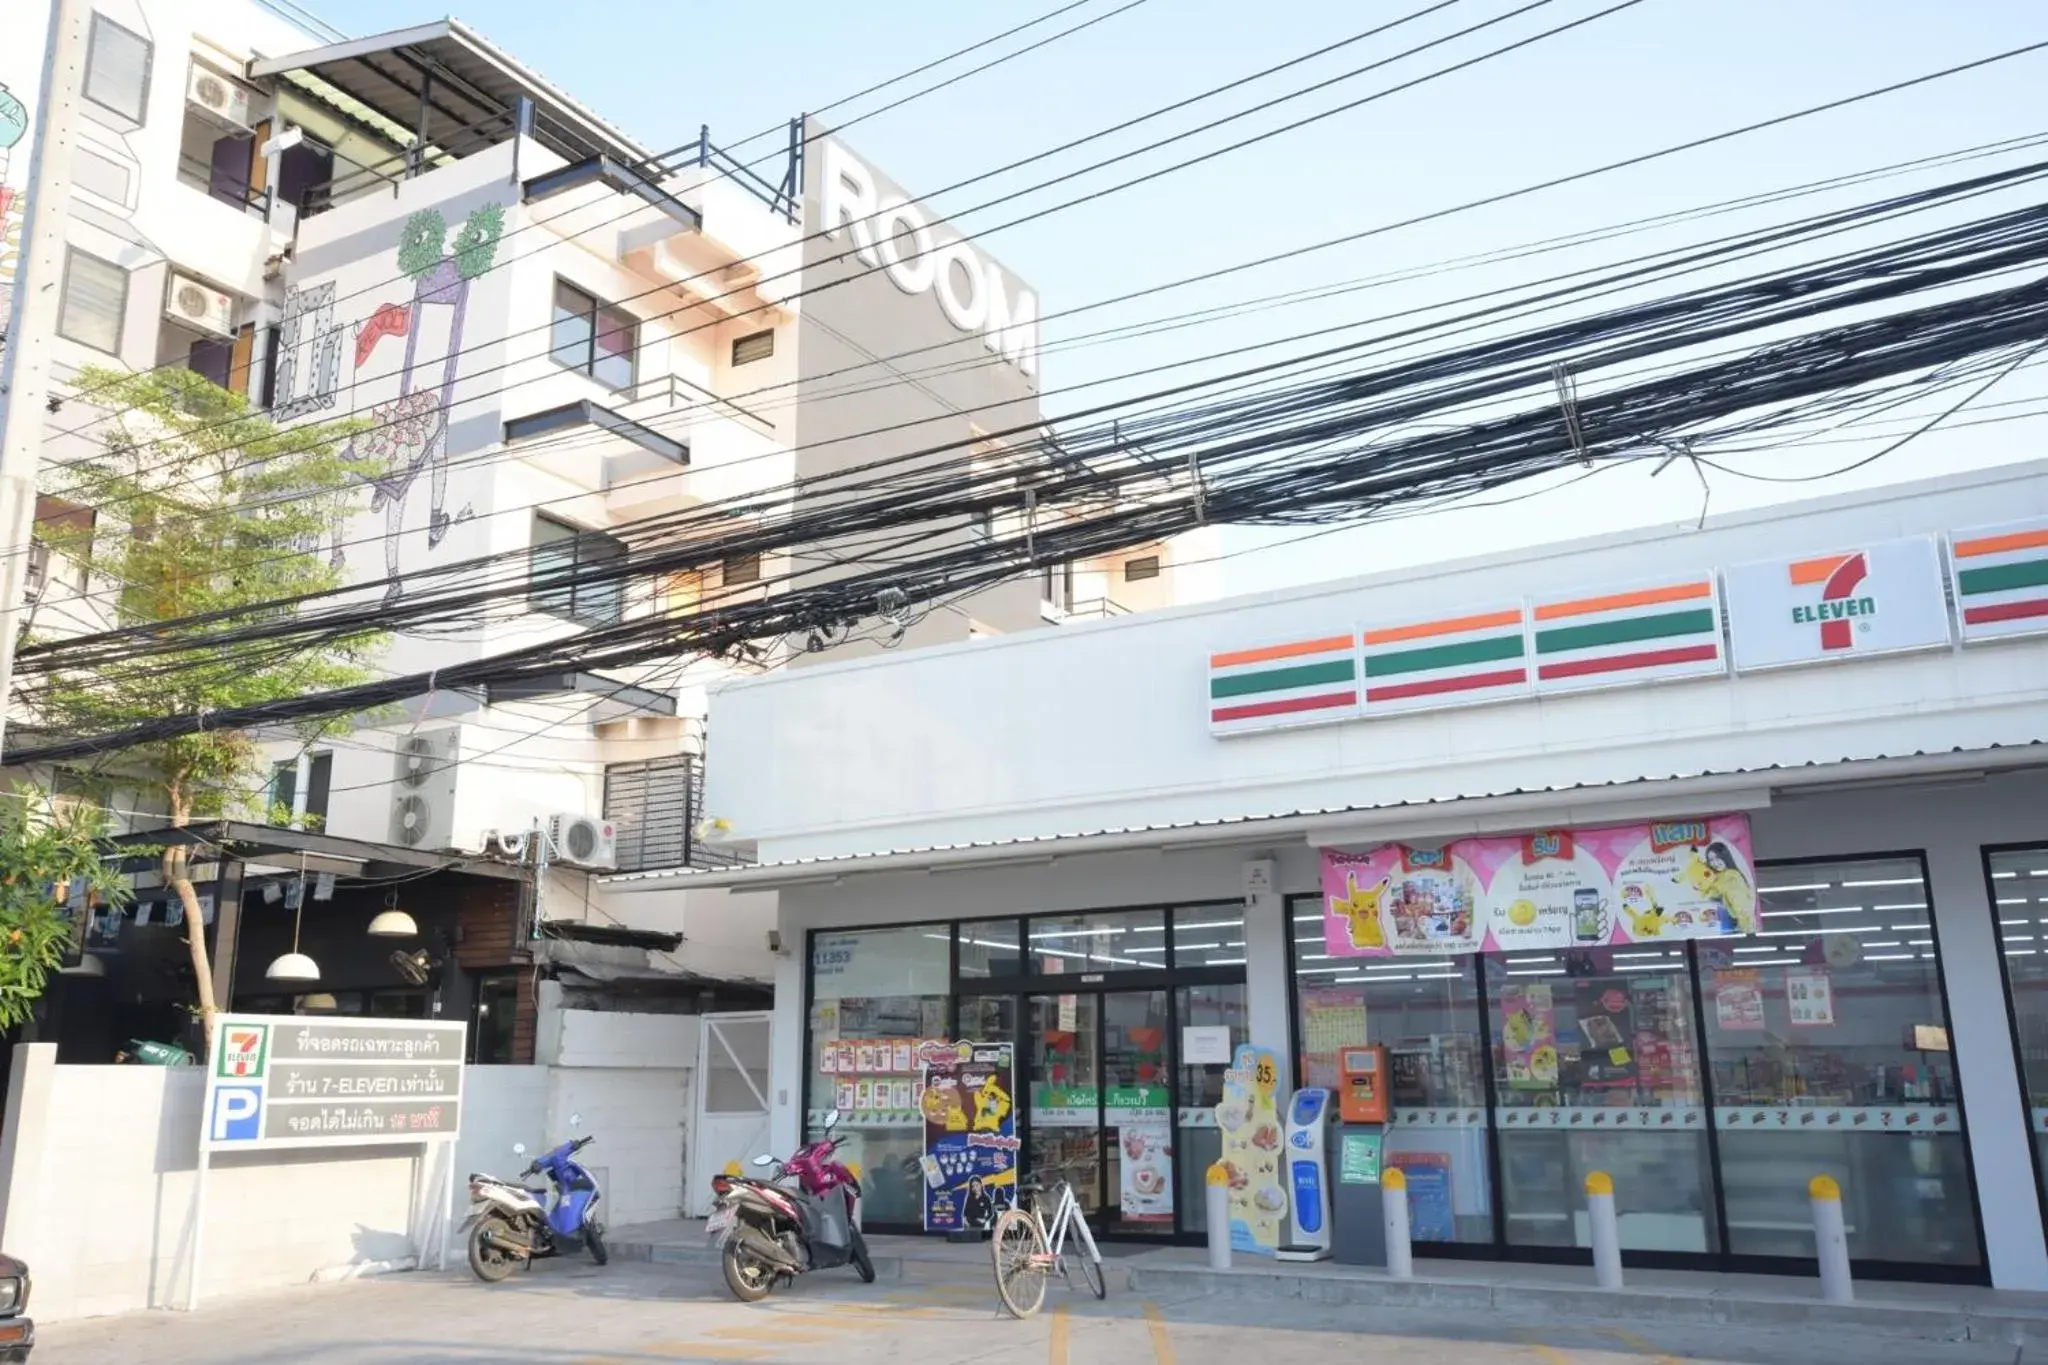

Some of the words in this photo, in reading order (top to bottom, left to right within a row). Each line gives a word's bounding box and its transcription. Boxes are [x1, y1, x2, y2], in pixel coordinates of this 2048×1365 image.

[821, 138, 1038, 377] ROOM
[1789, 552, 1867, 650] 7
[229, 1033, 258, 1075] 7
[286, 1071, 317, 1094] ร้าน
[400, 1068, 444, 1093] เท่านั้น
[213, 1088, 258, 1140] P
